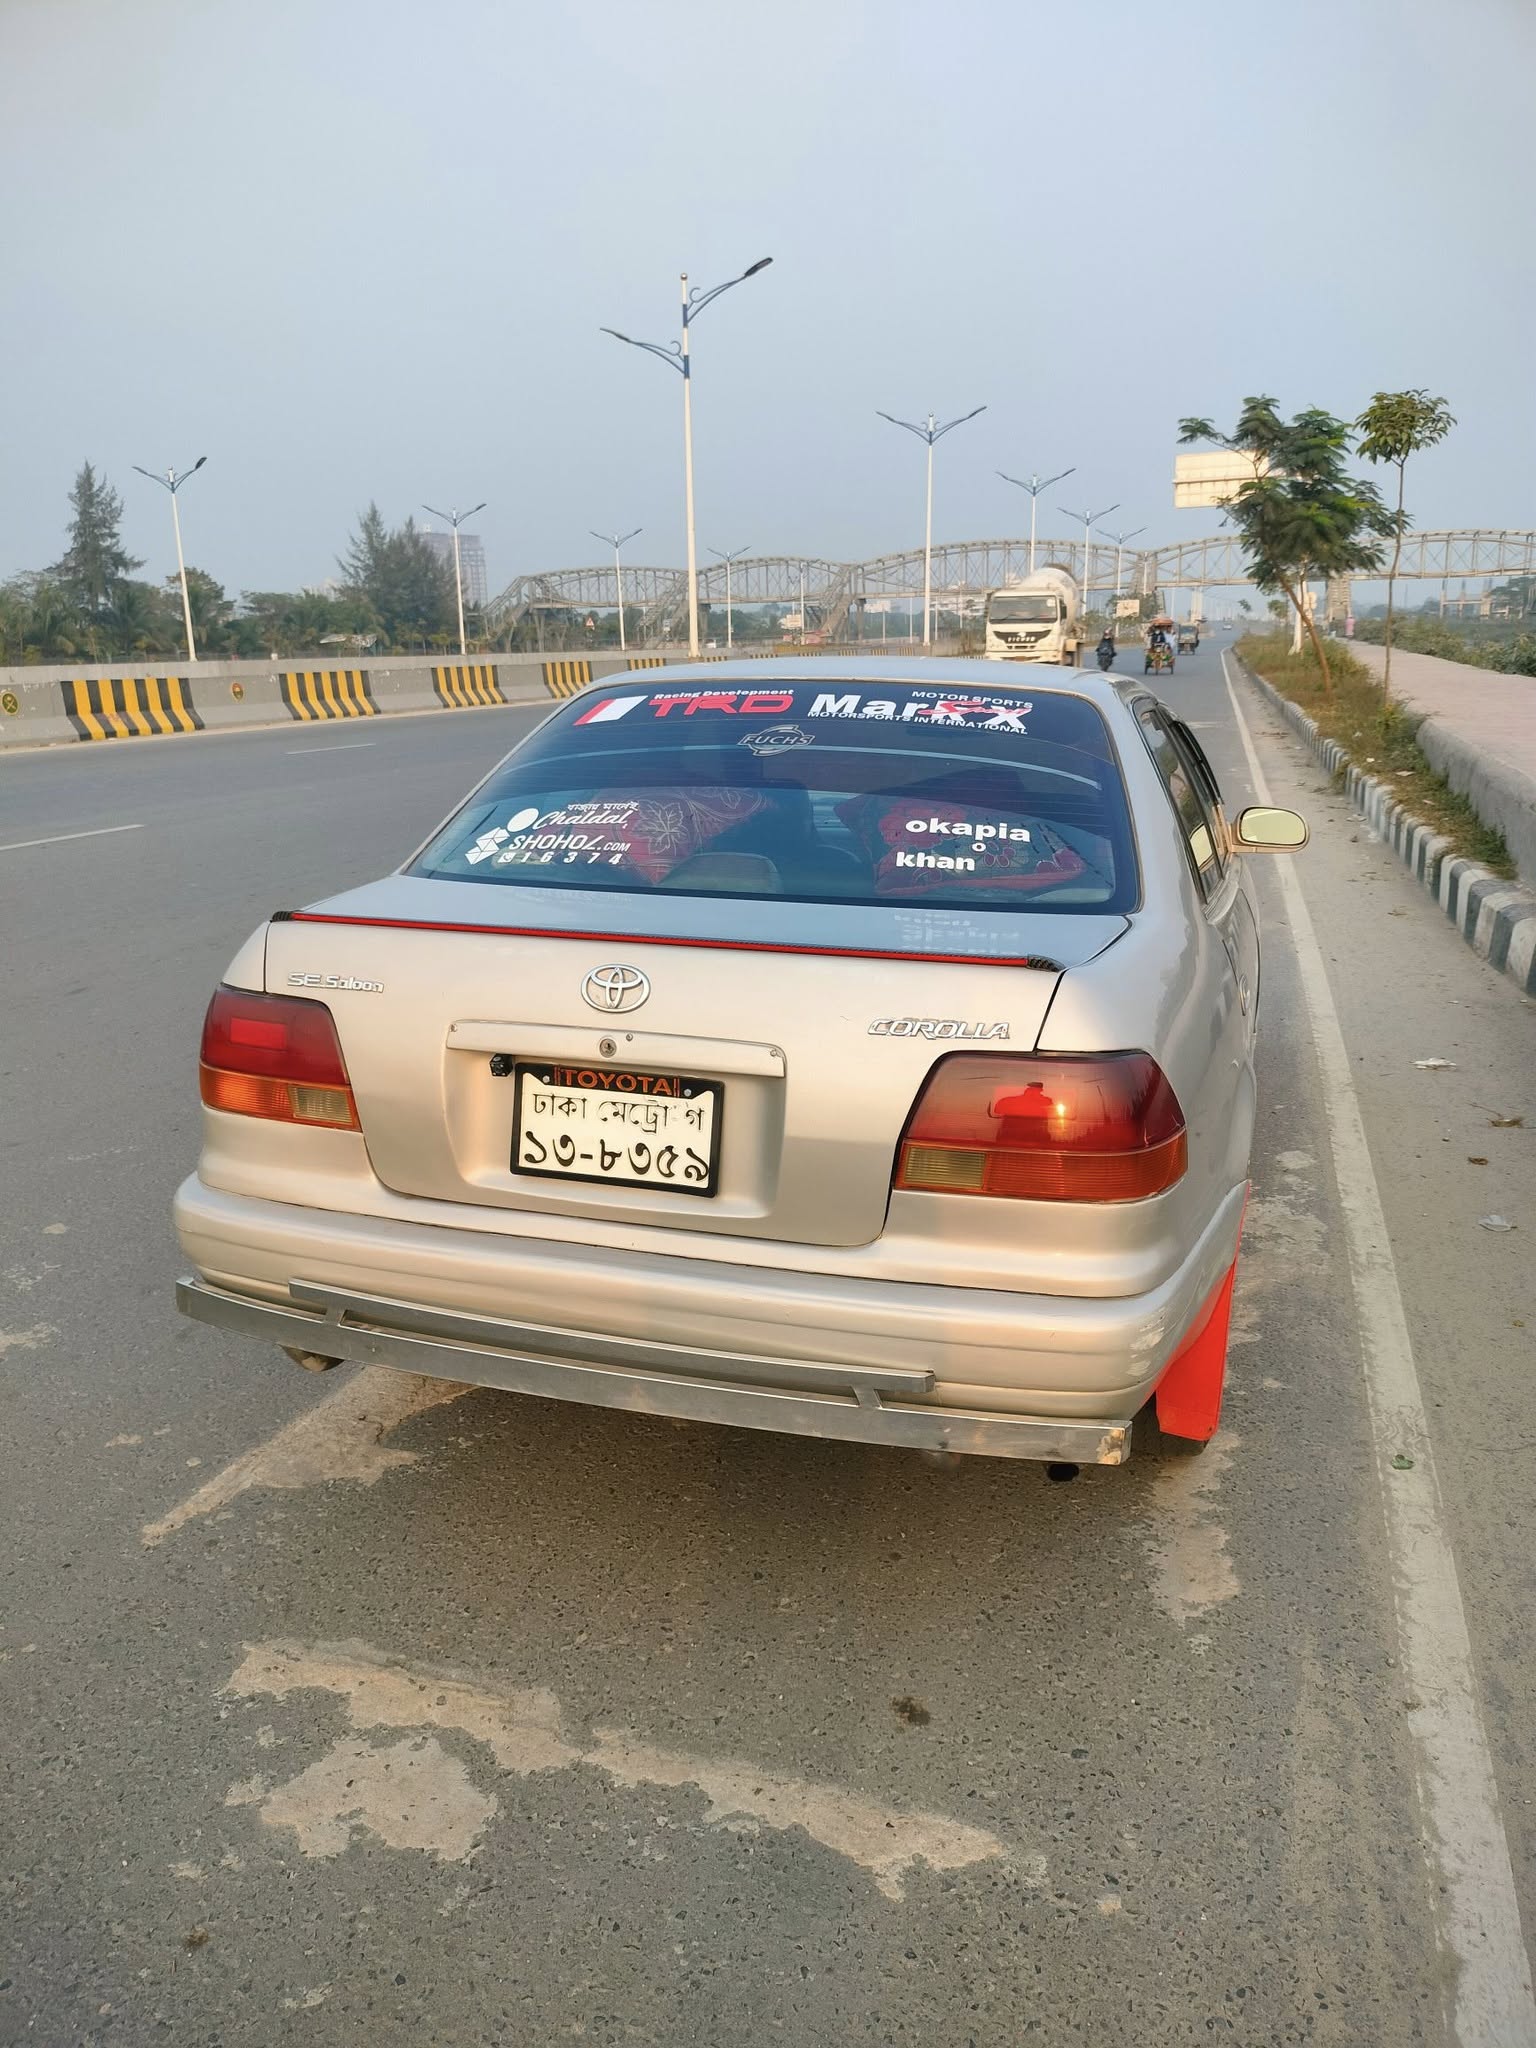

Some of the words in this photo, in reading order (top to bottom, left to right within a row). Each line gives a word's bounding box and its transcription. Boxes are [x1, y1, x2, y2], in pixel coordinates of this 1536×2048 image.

[649, 694, 794, 717] TRD
[653, 692, 701, 700] Racing
[702, 689, 794, 697] Development
[911, 690, 968, 702] MOTOR
[972, 696, 1034, 710] SPORTS
[807, 711, 911, 722] MOTORSPORTS
[913, 716, 1029, 735] INTERNATIONAL
[743, 735, 810, 745] FUCHS
[905, 817, 1031, 843] okapia
[895, 851, 976, 871] khan
[287, 972, 322, 989] SE
[325, 975, 385, 993] Saloon
[867, 1017, 1010, 1040] COROLLA
[560, 1068, 672, 1097] TOYOTA
[533, 1093, 588, 1119] ঢাকা
[598, 1099, 670, 1135] মেট্রো
[685, 1107, 705, 1131] গ
[523, 1130, 710, 1182] ১৩-৮৩৫৯
